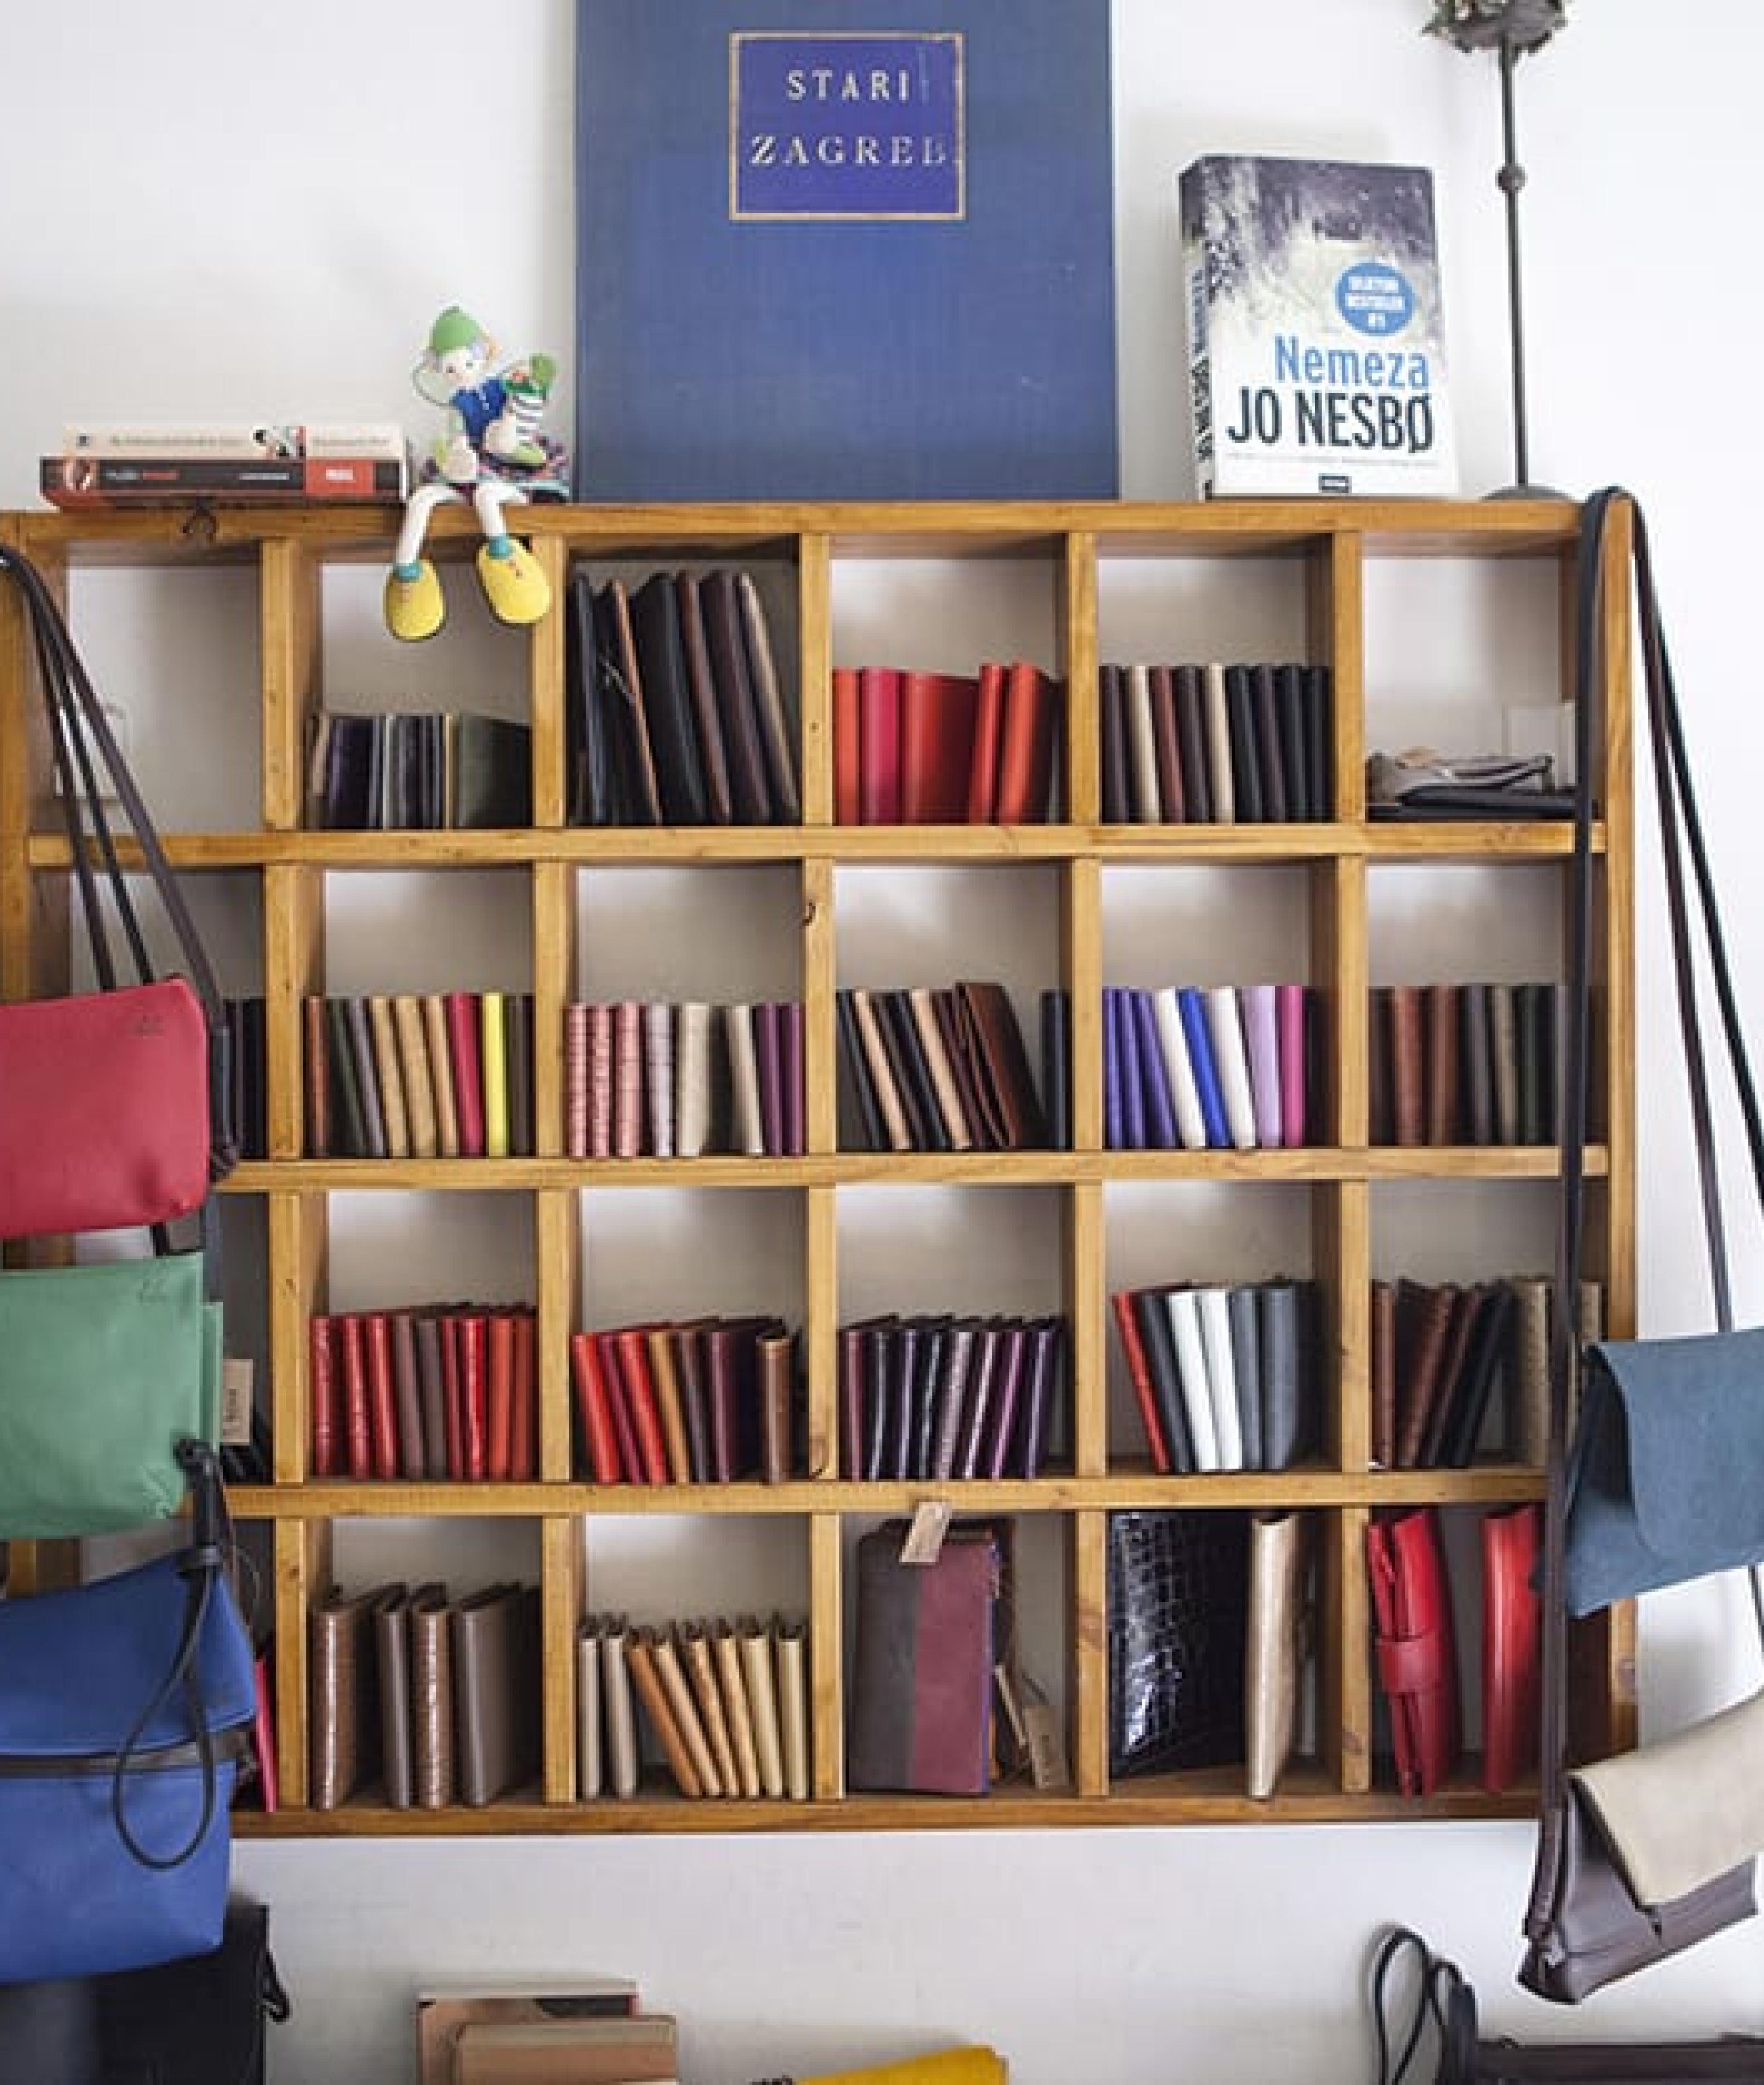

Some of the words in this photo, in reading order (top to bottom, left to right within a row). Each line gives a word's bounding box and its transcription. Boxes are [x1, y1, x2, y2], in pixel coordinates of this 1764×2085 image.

[786, 69, 909, 100] STARI
[1275, 336, 1430, 389] Nemeza
[1227, 386, 1281, 443] JO
[1295, 389, 1433, 452] NESBØ
